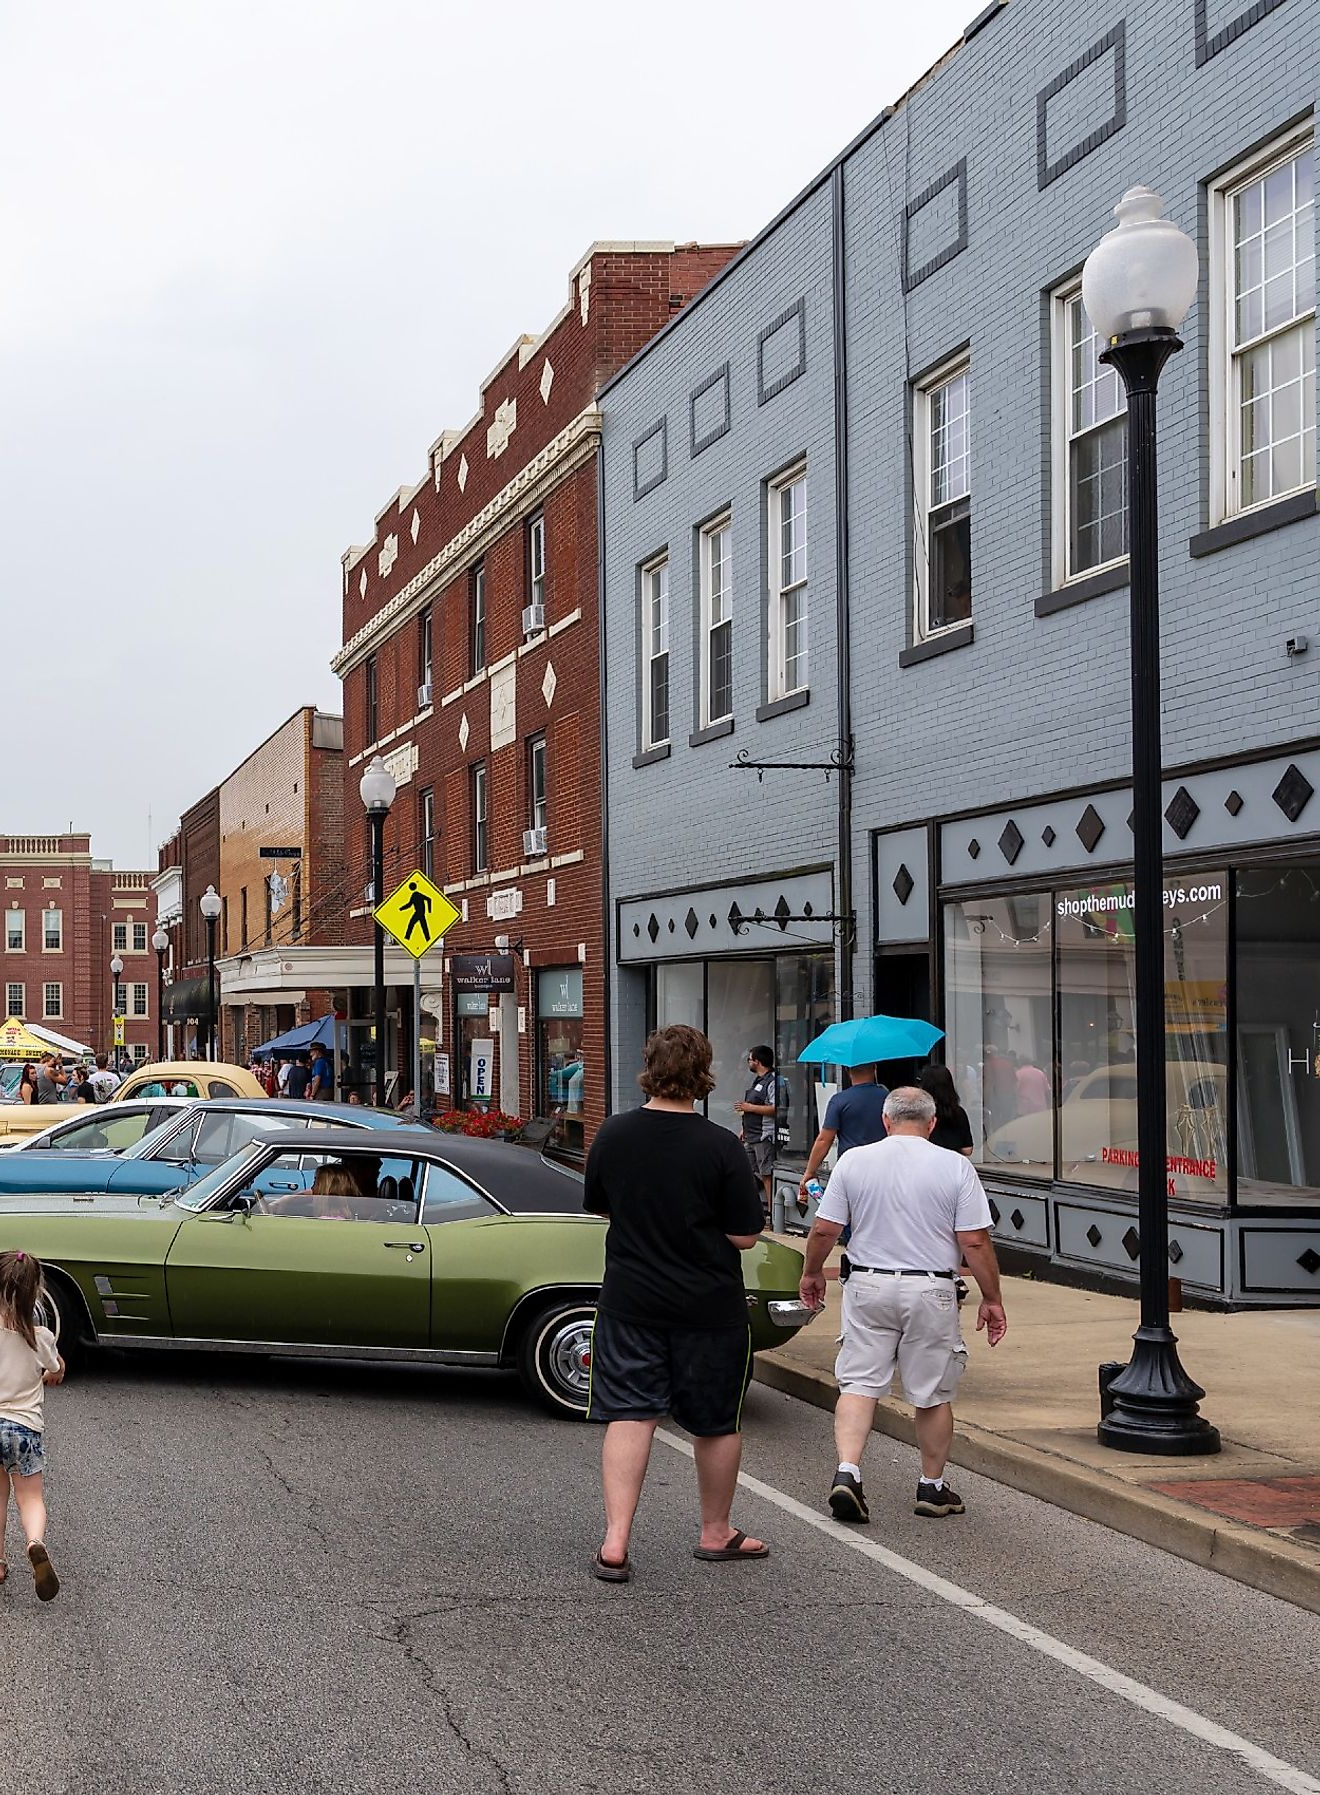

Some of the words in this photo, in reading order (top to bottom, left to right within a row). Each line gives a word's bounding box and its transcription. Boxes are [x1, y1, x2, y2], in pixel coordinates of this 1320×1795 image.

[1057, 884, 1221, 916] shopthemudeys.com
[457, 976, 488, 984] walker
[490, 976, 511, 984] lane
[476, 1058, 487, 1095] OPEN
